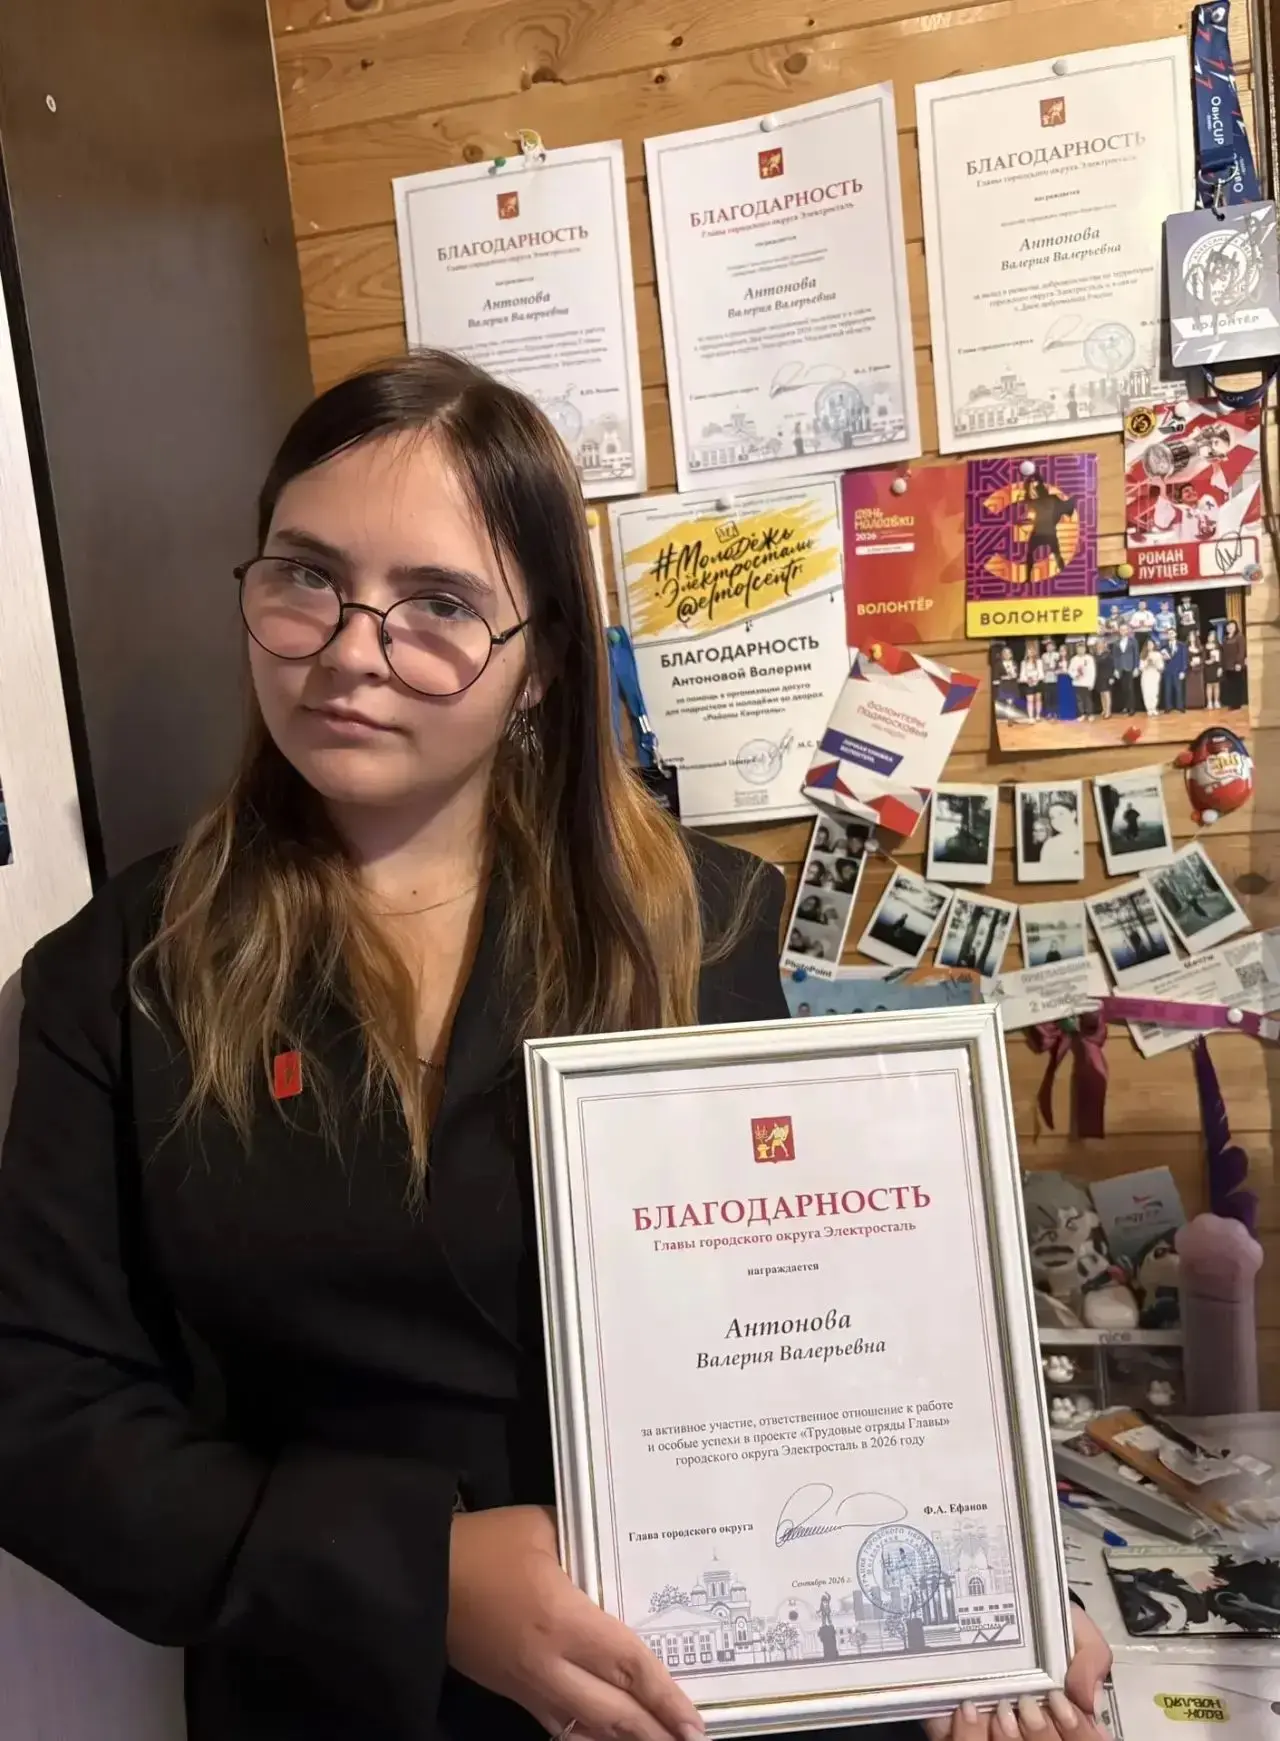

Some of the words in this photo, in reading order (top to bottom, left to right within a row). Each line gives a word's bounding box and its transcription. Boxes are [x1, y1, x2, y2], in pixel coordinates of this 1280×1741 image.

[966, 131, 1146, 176] БЛАГОДАРНОСТЬ
[689, 178, 863, 228] БЛАГОДАРНОСТЬ
[437, 225, 589, 261] БЛАГОДАРНОСТЬ
[1019, 227, 1100, 252] Антонова
[1001, 254, 1050, 271] Валерия
[1053, 243, 1122, 263] Валерьевна
[743, 275, 817, 300] Антонова
[483, 290, 551, 311] Антонова
[727, 302, 773, 319] Валерия
[1138, 549, 1184, 566] РОМАН
[1138, 563, 1189, 580] ЛУТЦЕВ
[856, 596, 934, 616] ВОЛОНТЁР
[980, 606, 1084, 626] ВОЛОНТЁР
[660, 635, 820, 668] БЛАГОДАРНОСТЬ
[671, 668, 746, 688] Антоновой
[750, 662, 812, 678] Валерии
[784, 958, 833, 978] PhotoPoint
[632, 1185, 931, 1231] БЛАГОДАРНОСТЬ
[654, 1240, 696, 1251] Главы
[700, 1233, 773, 1250] городского
[776, 1229, 821, 1243] округа
[823, 1222, 917, 1238] Электросталь
[747, 1263, 820, 1277] награждается
[724, 1308, 852, 1339] Антонова
[696, 1350, 774, 1370] Валерия
[780, 1338, 886, 1362] Валерьевна
[641, 1427, 653, 1437] за
[655, 1423, 707, 1436] активное
[709, 1418, 757, 1433] участие,
[759, 1411, 840, 1427] ответственное
[842, 1406, 904, 1419] отношение
[906, 1404, 914, 1413] к
[916, 1400, 954, 1415] работе
[648, 1444, 655, 1452] и
[658, 1438, 699, 1452] особые
[701, 1436, 741, 1450] успехи
[744, 1435, 751, 1443] в
[753, 1430, 797, 1445] проекте
[800, 1425, 863, 1440] «Трудовые
[865, 1421, 906, 1434] отряды
[908, 1416, 950, 1429] Главы»
[675, 1451, 739, 1467] городского
[741, 1447, 779, 1461] округа
[782, 1440, 859, 1457] Электросталь
[861, 1440, 868, 1448] в
[870, 1435, 898, 1448] 2026
[899, 1435, 926, 1447] году
[923, 1504, 948, 1515] Ф.А.
[949, 1502, 988, 1515] Ефанов
[628, 1531, 659, 1543] Глава
[661, 1526, 718, 1540] городского
[719, 1523, 754, 1535] округа
[791, 1578, 827, 1589] Сентябрь
[828, 1575, 846, 1586] 2026
